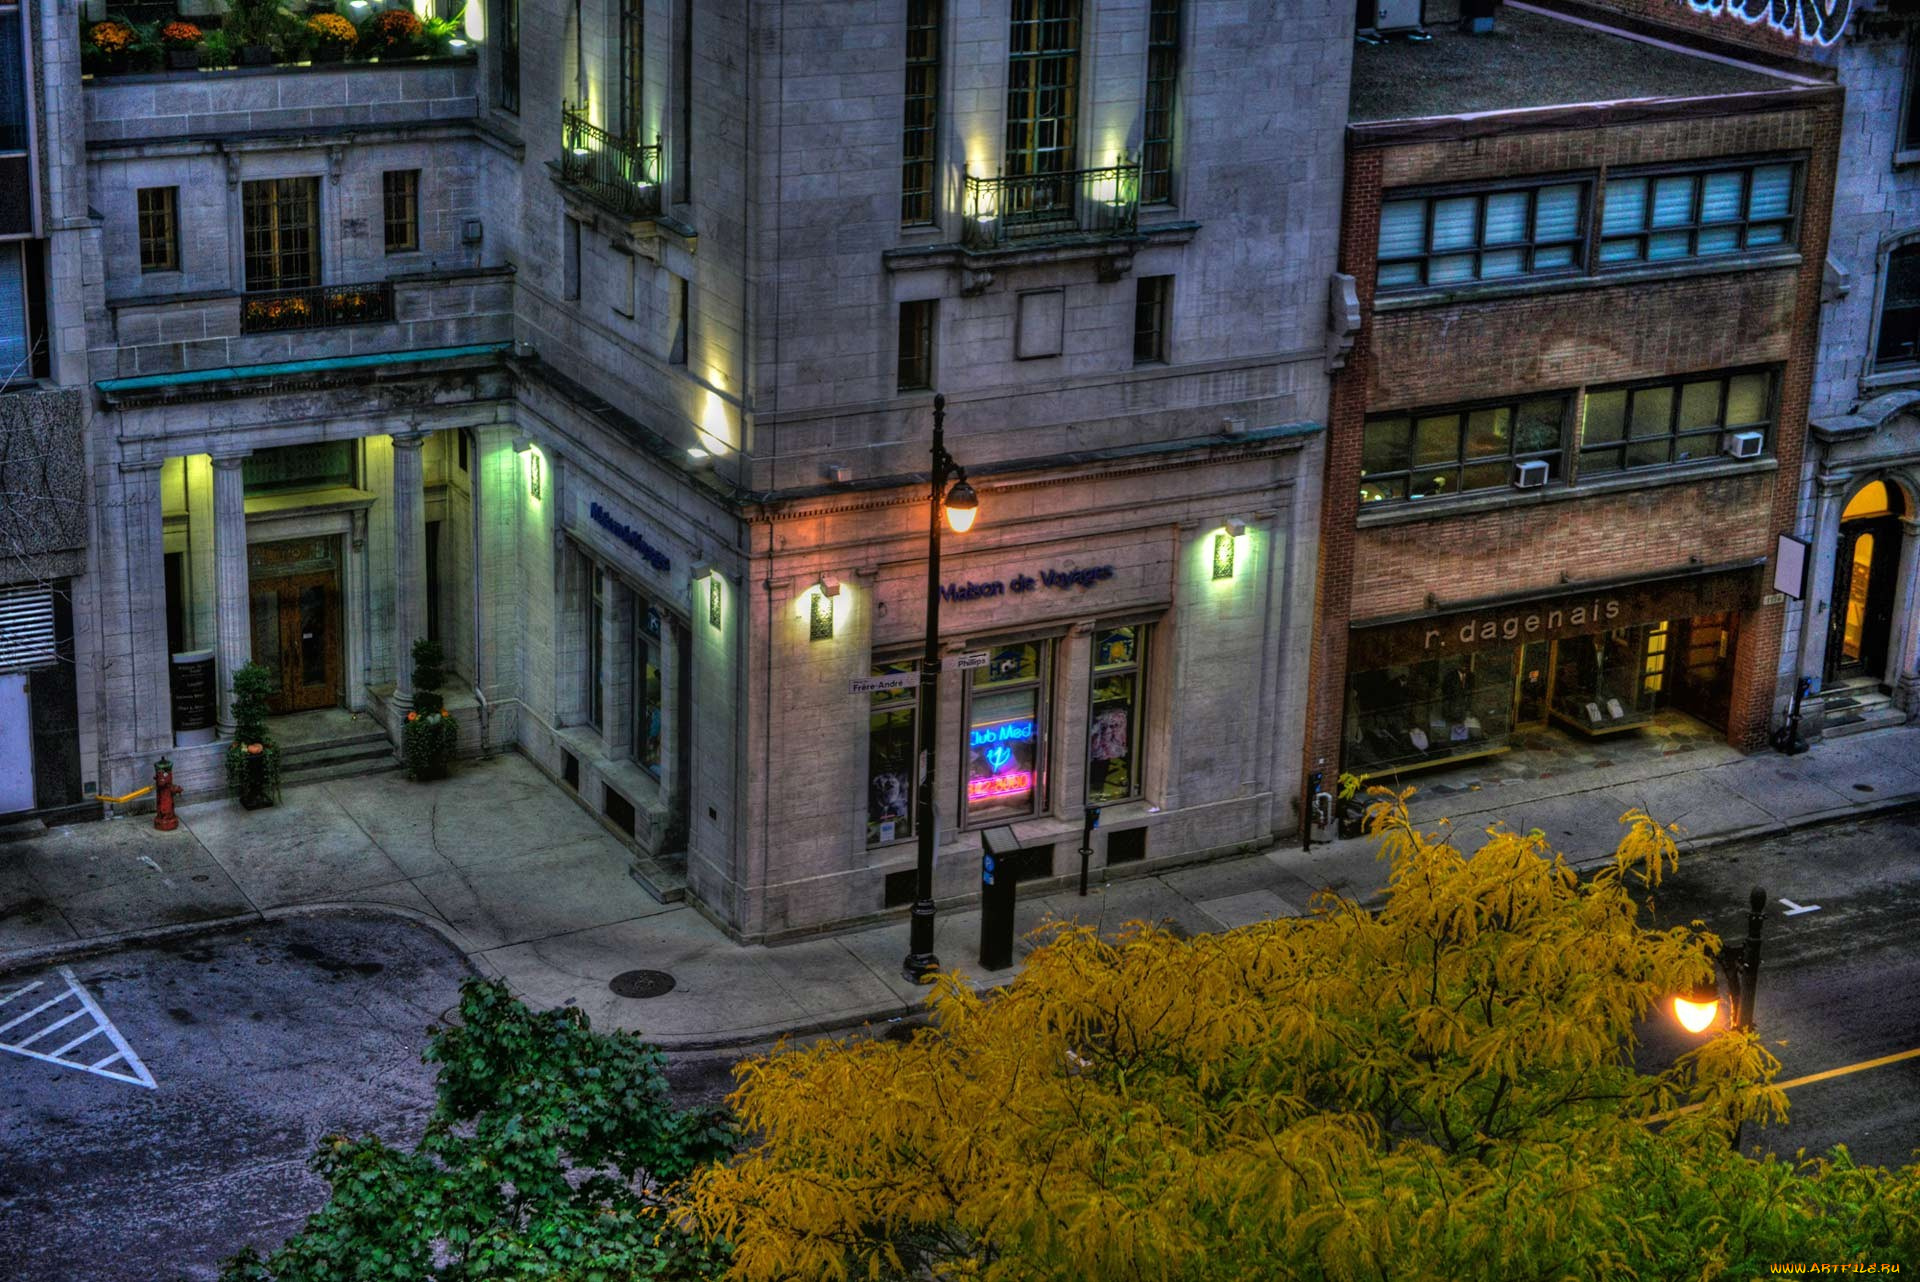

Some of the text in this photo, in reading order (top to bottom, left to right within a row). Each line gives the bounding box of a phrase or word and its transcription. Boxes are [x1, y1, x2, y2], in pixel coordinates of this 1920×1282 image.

[939, 564, 1115, 603] Maison de Voyages
[1424, 598, 1621, 649] r. dagenais
[998, 721, 1032, 741] Med
